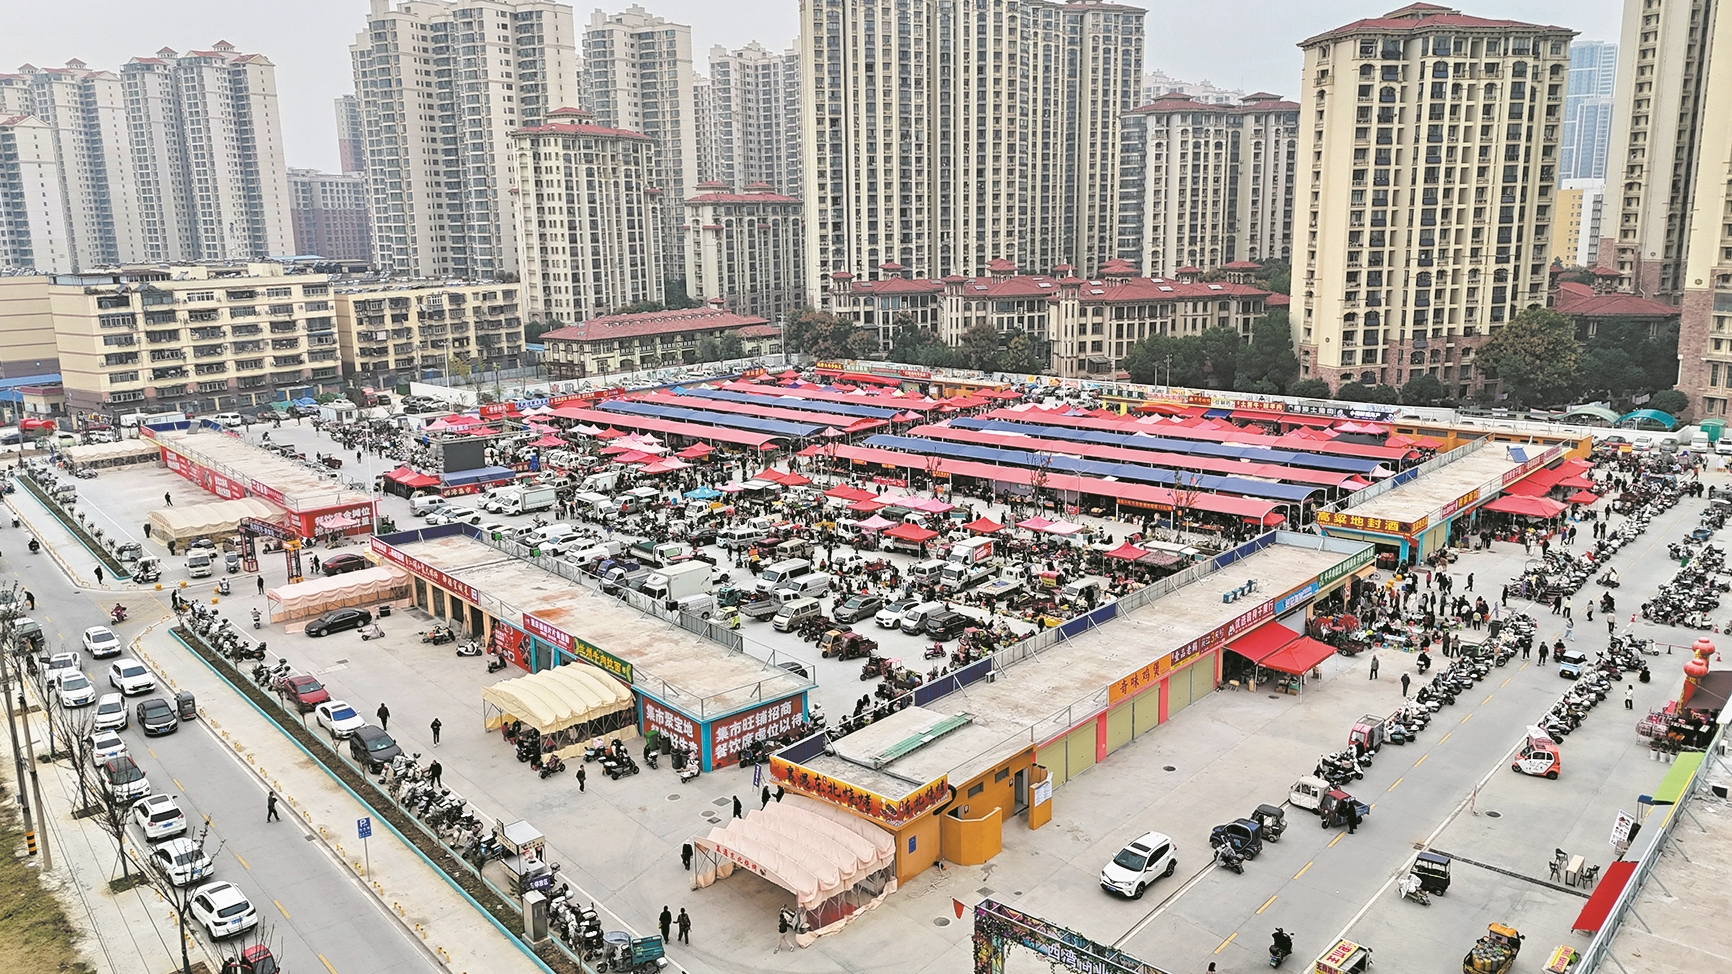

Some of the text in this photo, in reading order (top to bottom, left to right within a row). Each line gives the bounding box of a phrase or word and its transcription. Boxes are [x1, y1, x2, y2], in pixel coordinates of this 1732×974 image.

[1317, 511, 1399, 532] 高粱地封酒
[579, 643, 622, 673] 兰州牛肉拉面
[1119, 661, 1160, 695] 奇味鸡煲
[645, 703, 694, 738] 集市聚宝地
[715, 701, 792, 743] 集市旺铺招商
[903, 780, 946, 816] 东北烧烤
[360, 819, 366, 827] P
